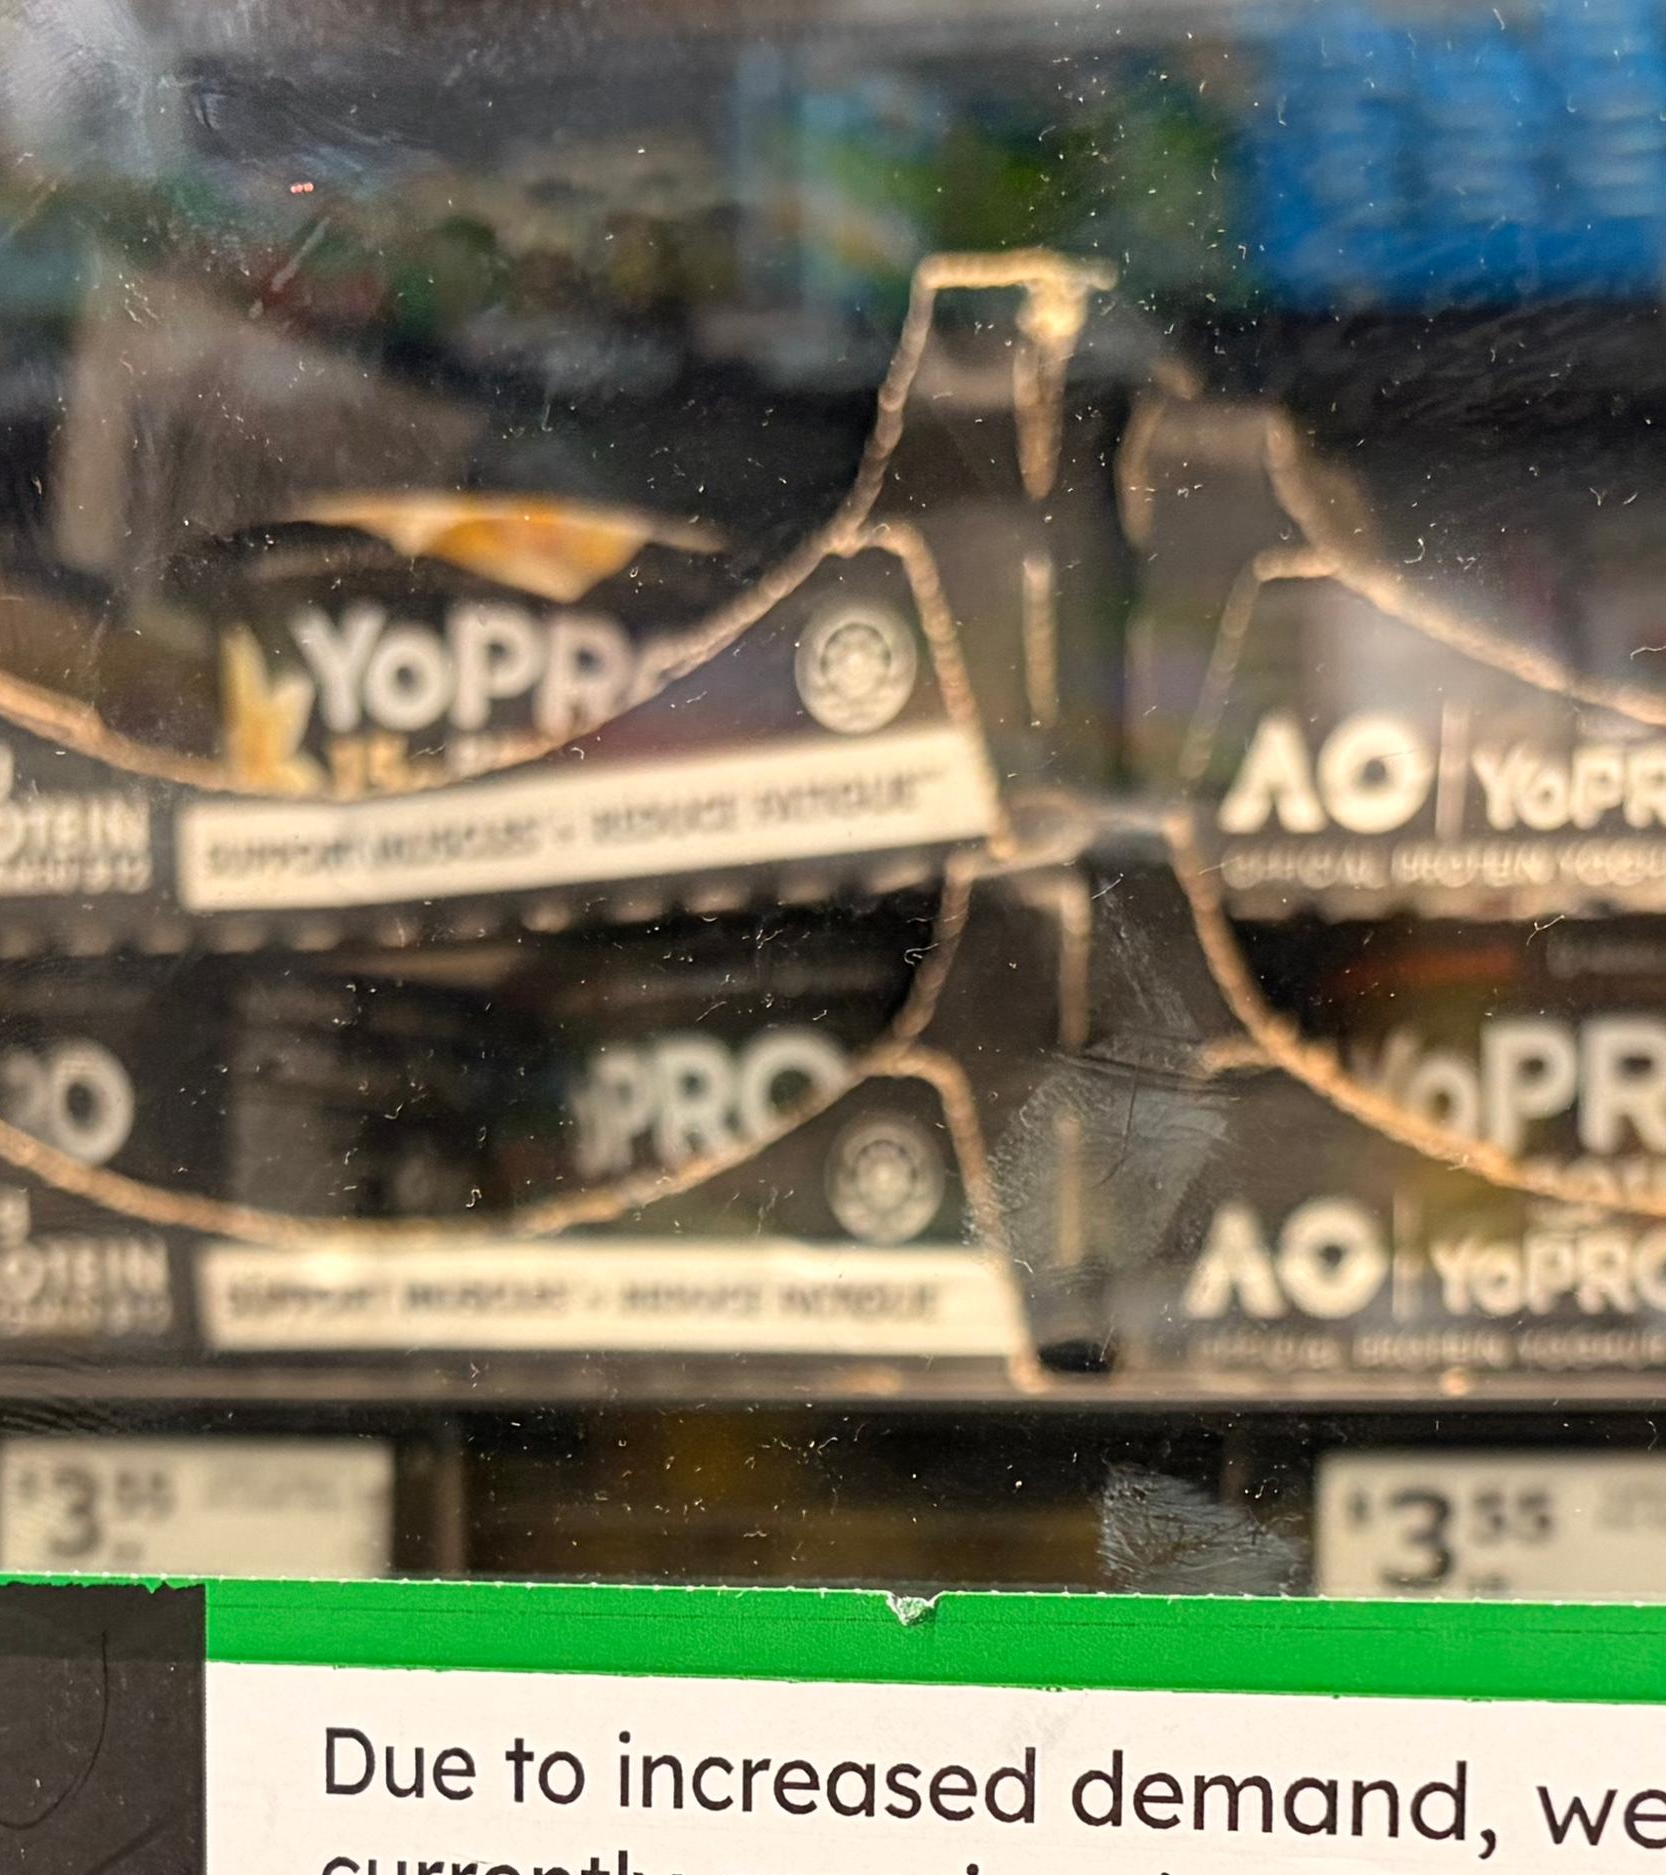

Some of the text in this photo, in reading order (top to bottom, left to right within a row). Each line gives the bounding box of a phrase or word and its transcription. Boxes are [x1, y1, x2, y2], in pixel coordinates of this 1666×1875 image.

[325, 1726, 476, 1801] Due
[505, 1737, 585, 1805] to
[618, 1731, 1036, 1824] increased
[1071, 1749, 1498, 1860] demand,
